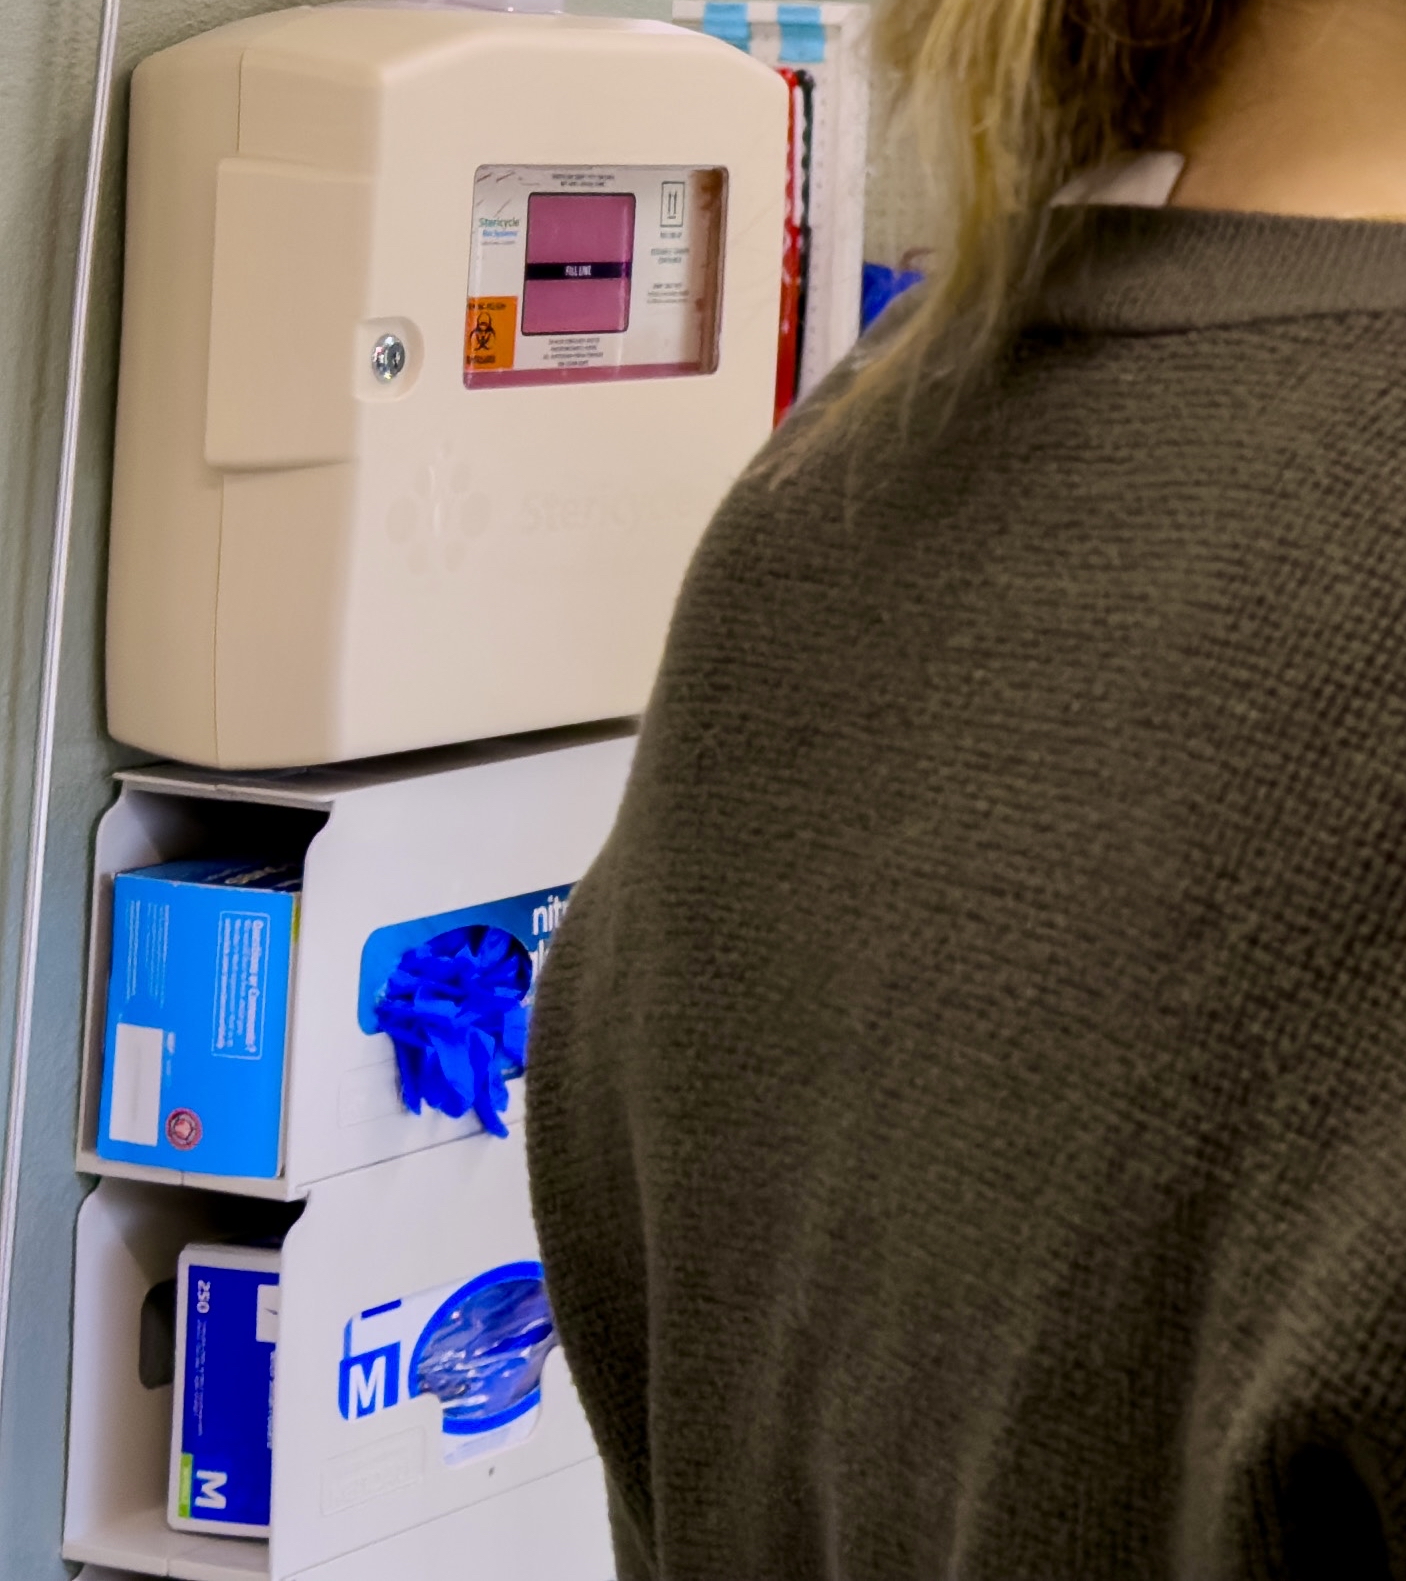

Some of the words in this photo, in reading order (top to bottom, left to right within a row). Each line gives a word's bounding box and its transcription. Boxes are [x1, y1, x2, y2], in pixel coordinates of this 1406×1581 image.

[196, 1279, 211, 1314] 250
[348, 1355, 387, 1420] M
[194, 1469, 228, 1510] M
